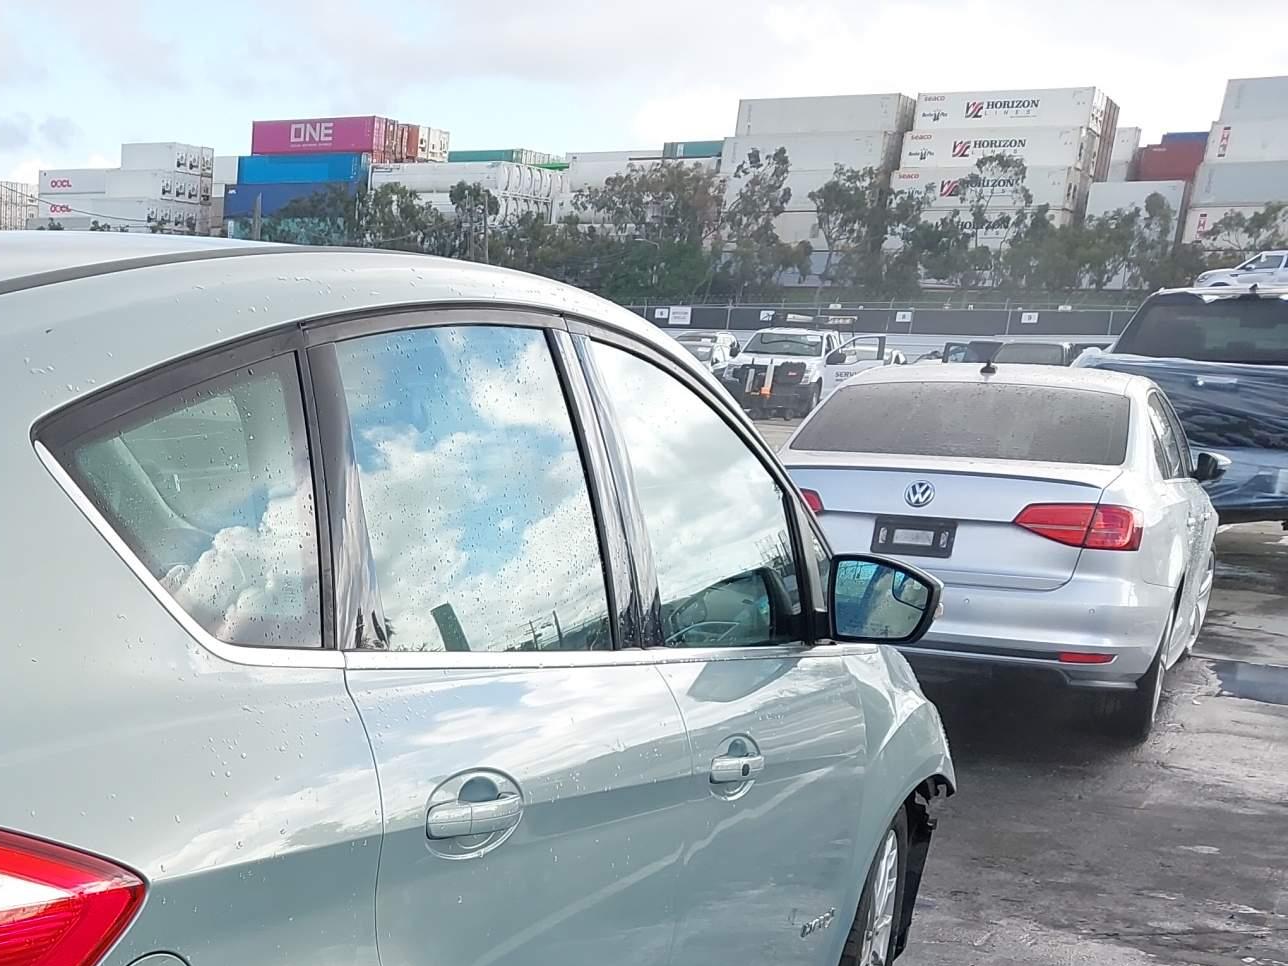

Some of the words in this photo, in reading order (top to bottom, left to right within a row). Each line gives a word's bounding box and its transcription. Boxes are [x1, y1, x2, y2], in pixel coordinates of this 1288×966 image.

[985, 99, 1041, 110] HORIZON
[290, 122, 334, 143] ONE
[973, 139, 1027, 149] HORIZON
[50, 179, 72, 188] OOCL
